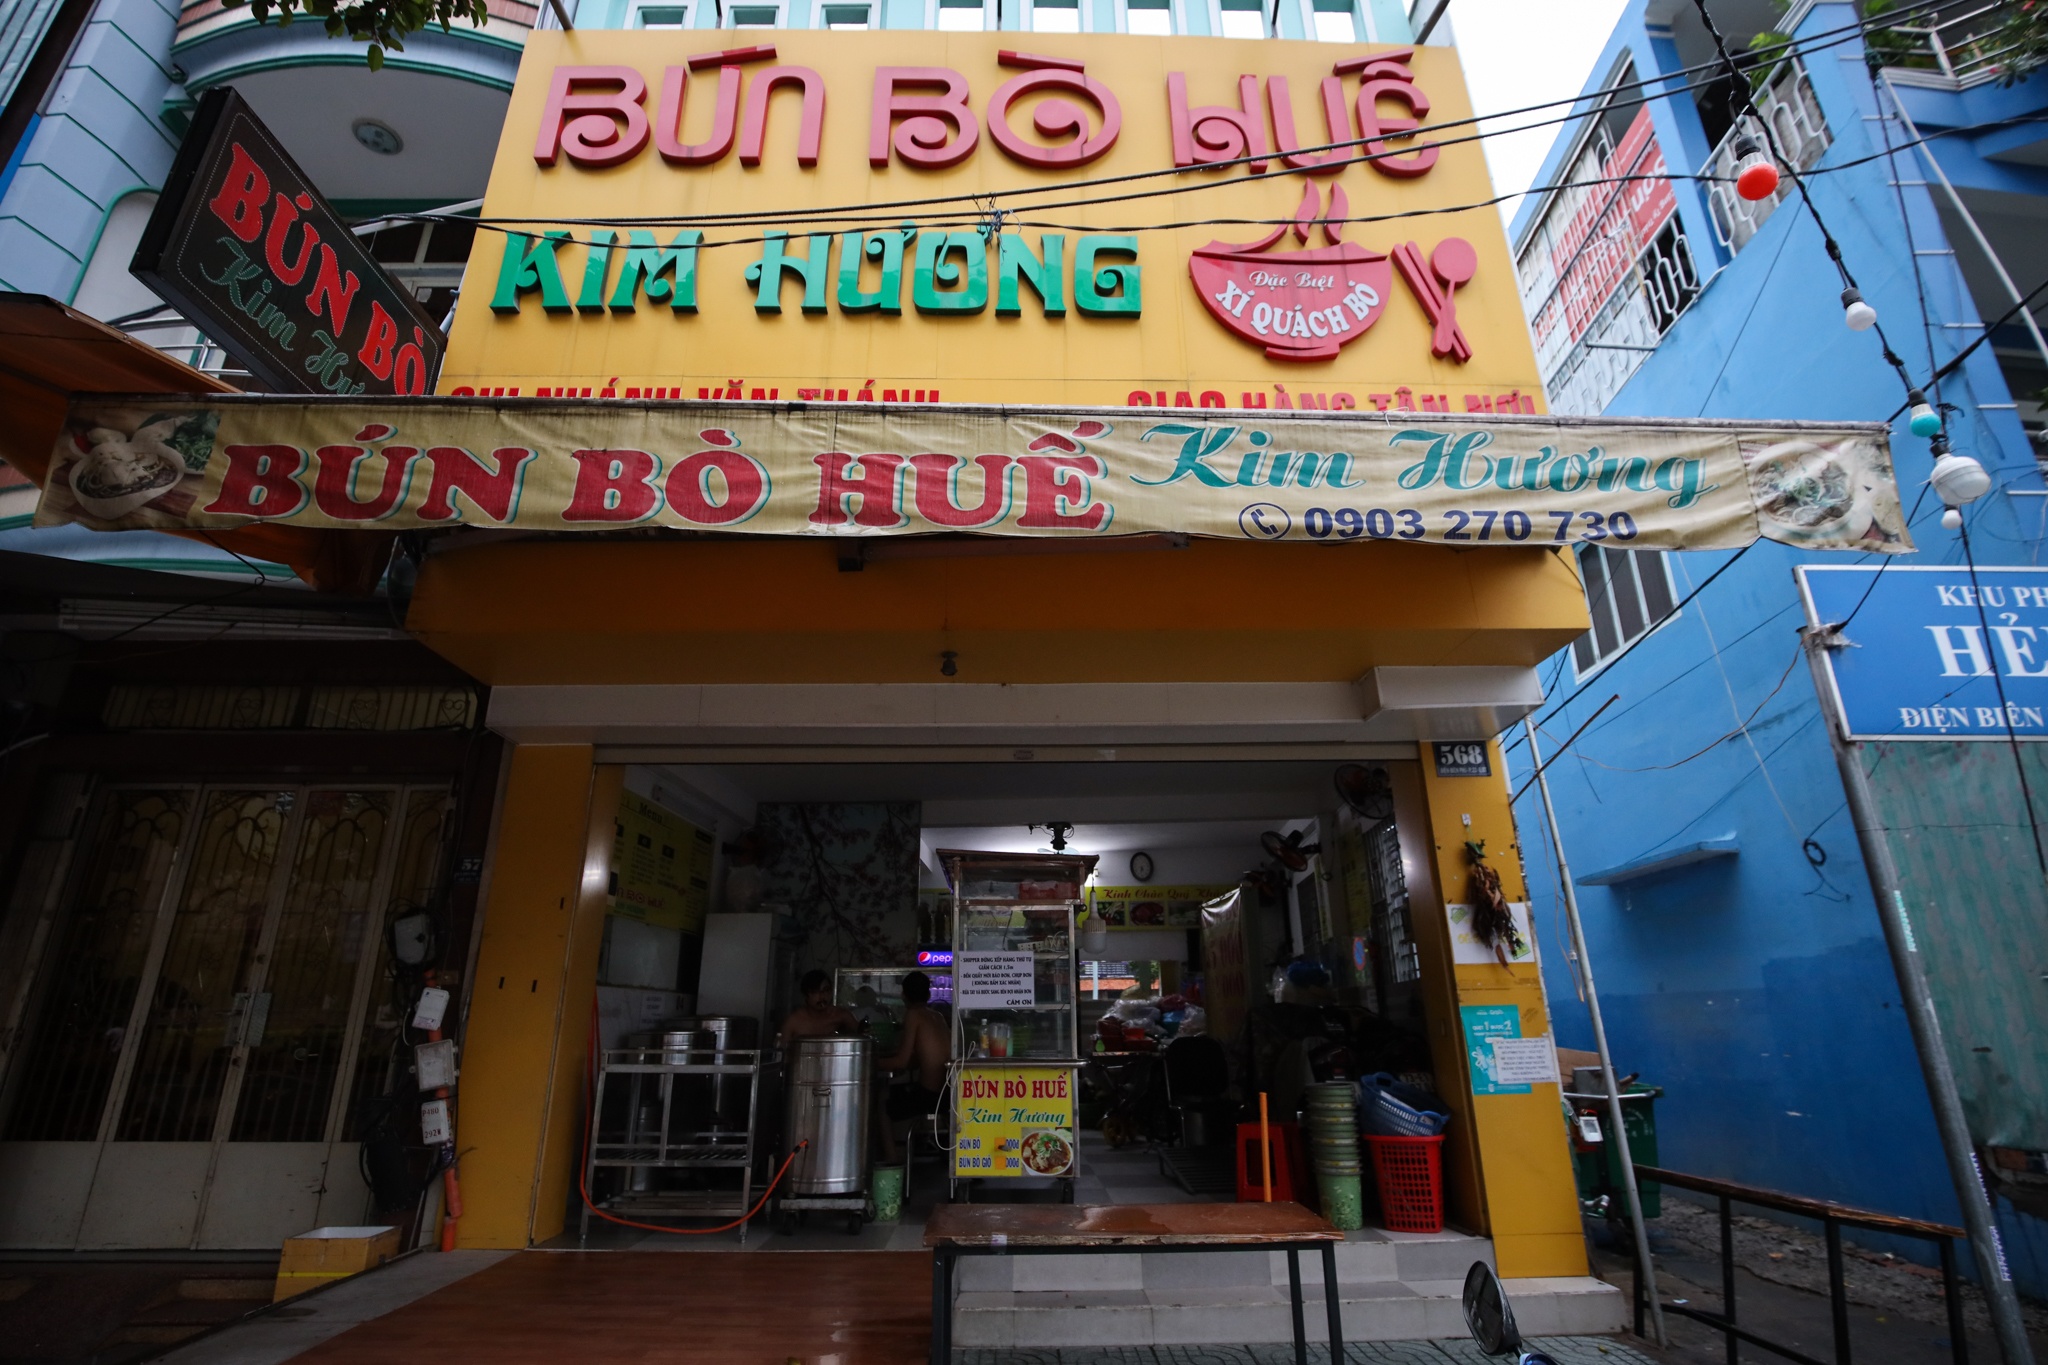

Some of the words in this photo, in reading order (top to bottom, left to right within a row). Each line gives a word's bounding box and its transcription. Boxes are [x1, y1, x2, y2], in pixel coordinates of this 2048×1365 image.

[533, 43, 826, 169] BÚN
[869, 50, 1122, 170] BÒ
[1168, 48, 1439, 178] HUẾ
[209, 142, 360, 338] BÚN
[357, 300, 427, 396] BÒ
[489, 230, 704, 315] KIM
[744, 219, 1141, 318] HƯƠNG
[1249, 270, 1288, 291] Đặc
[200, 236, 297, 351] Kim
[1251, 302, 1350, 338] QUÁCH
[1343, 280, 1380, 321] BÒ
[202, 424, 538, 524] BÚN
[561, 428, 771, 526] BÒ
[807, 420, 1114, 532] HUẾ
[1129, 423, 1366, 490] Kim
[1389, 429, 1721, 510] Hương
[1304, 507, 1426, 540] 0903
[1443, 509, 1532, 541] 270
[1548, 510, 1638, 541] 730
[1934, 585, 2006, 607] KHU
[1923, 612, 2048, 677] HẺ
[1898, 704, 1970, 733] ĐIỆN
[1974, 701, 2044, 728] BIÊN
[1440, 744, 1483, 765] 568
[638, 802, 663, 823] Menu
[932, 955, 953, 964] pep
[1504, 1020, 1512, 1030] 2
[962, 1075, 999, 1099] BÚN
[1004, 1075, 1027, 1099] BÒ
[1032, 1071, 1067, 1099] HUẾ
[965, 1108, 1003, 1123] Kim
[1009, 1108, 1066, 1126] Hương
[959, 1155, 971, 1168] BÚN
[973, 1155, 980, 1168] BÒ
